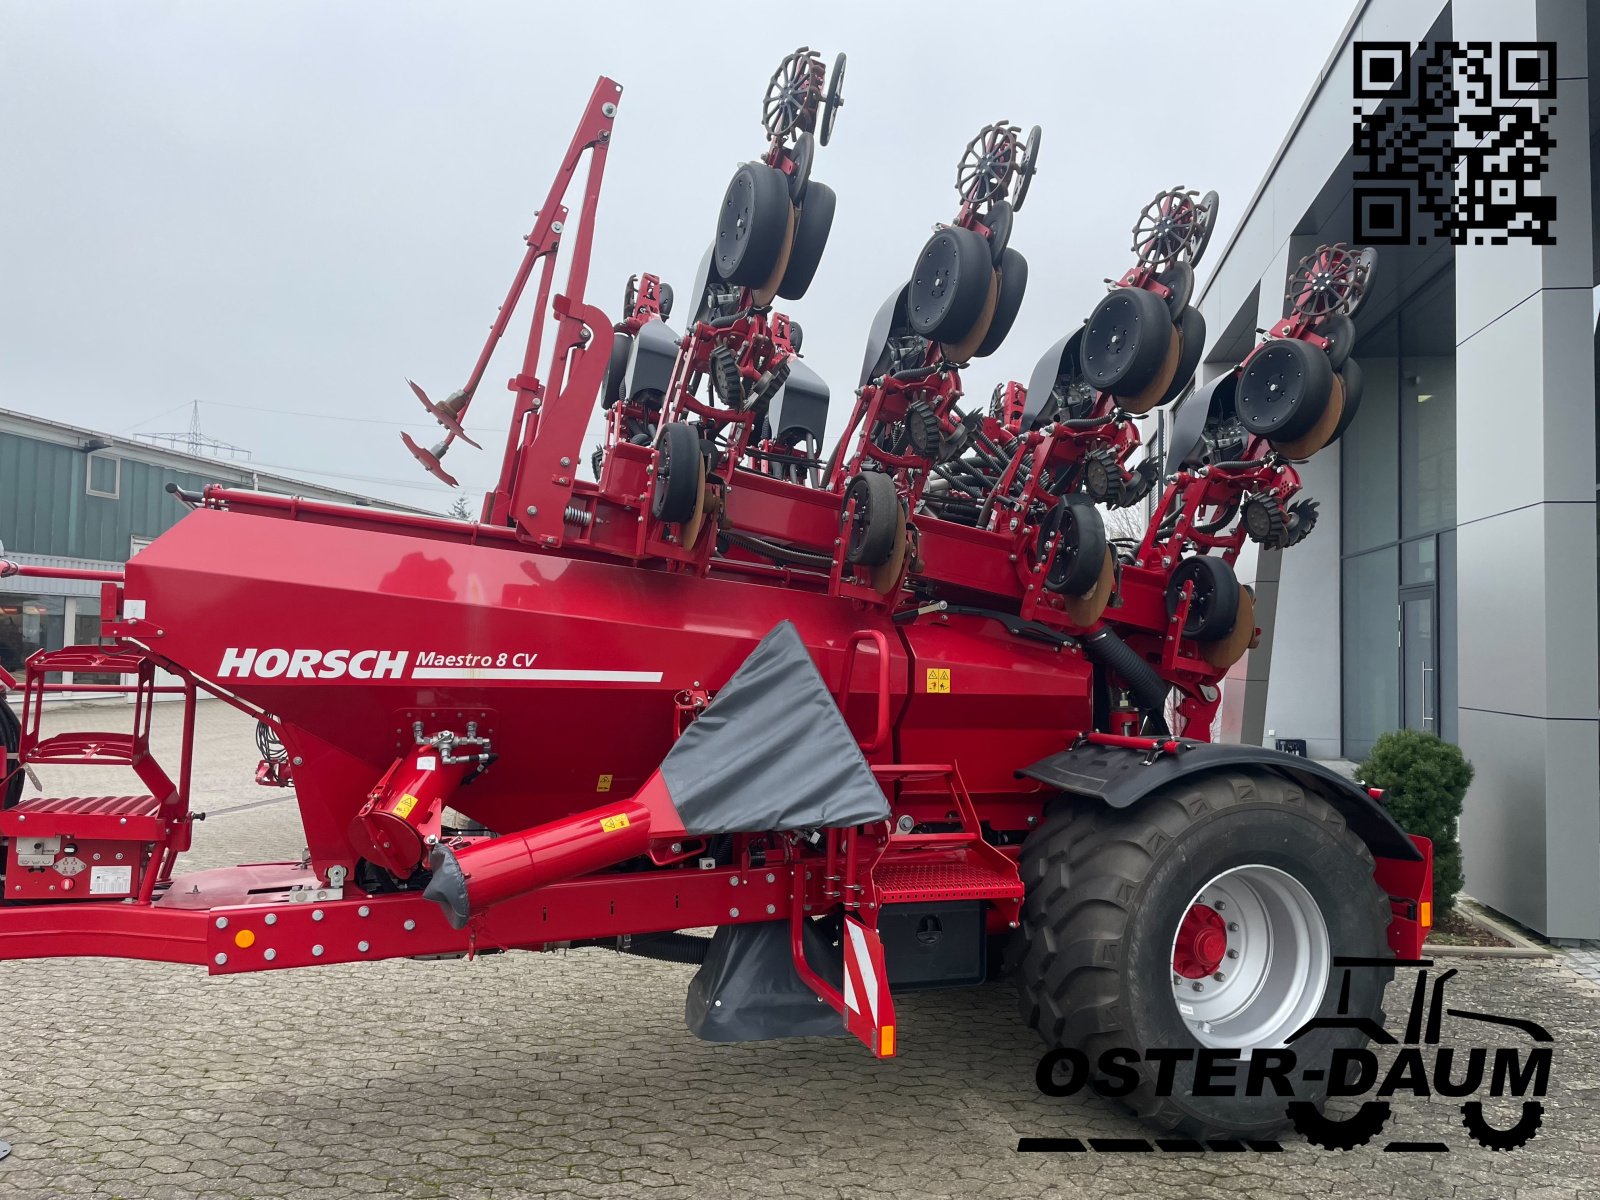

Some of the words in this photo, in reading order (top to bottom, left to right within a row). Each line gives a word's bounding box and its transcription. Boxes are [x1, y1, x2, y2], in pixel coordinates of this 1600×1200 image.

[217, 648, 409, 679] HORSCH
[415, 651, 492, 667] Maestro
[496, 653, 507, 667] 8
[512, 653, 538, 668] CV
